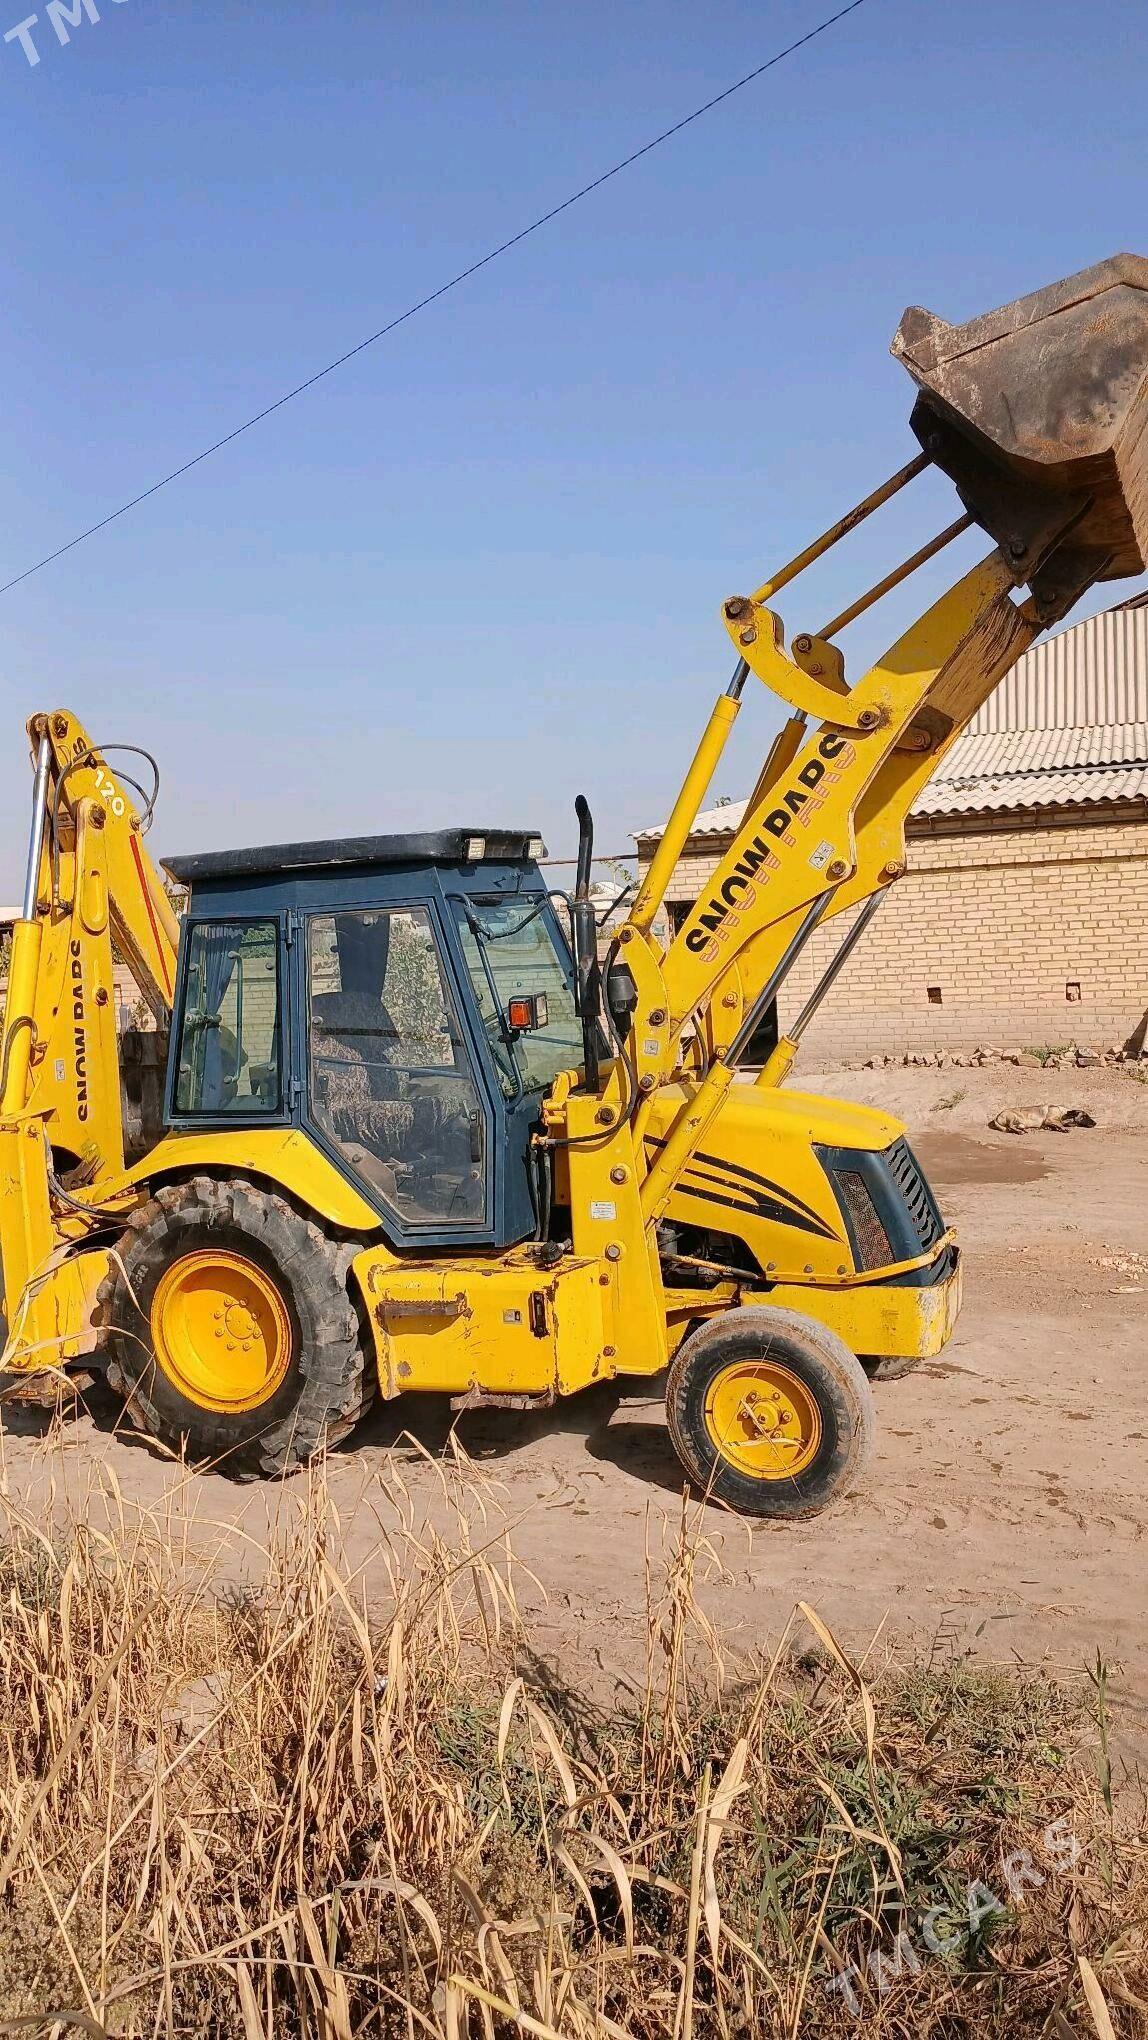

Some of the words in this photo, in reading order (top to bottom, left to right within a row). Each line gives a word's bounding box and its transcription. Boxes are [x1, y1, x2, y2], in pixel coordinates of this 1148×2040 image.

[95, 769, 125, 816] 120
[685, 836, 782, 962] SNOW
[762, 733, 857, 848] PARS
[74, 1027, 90, 1122] SNOW
